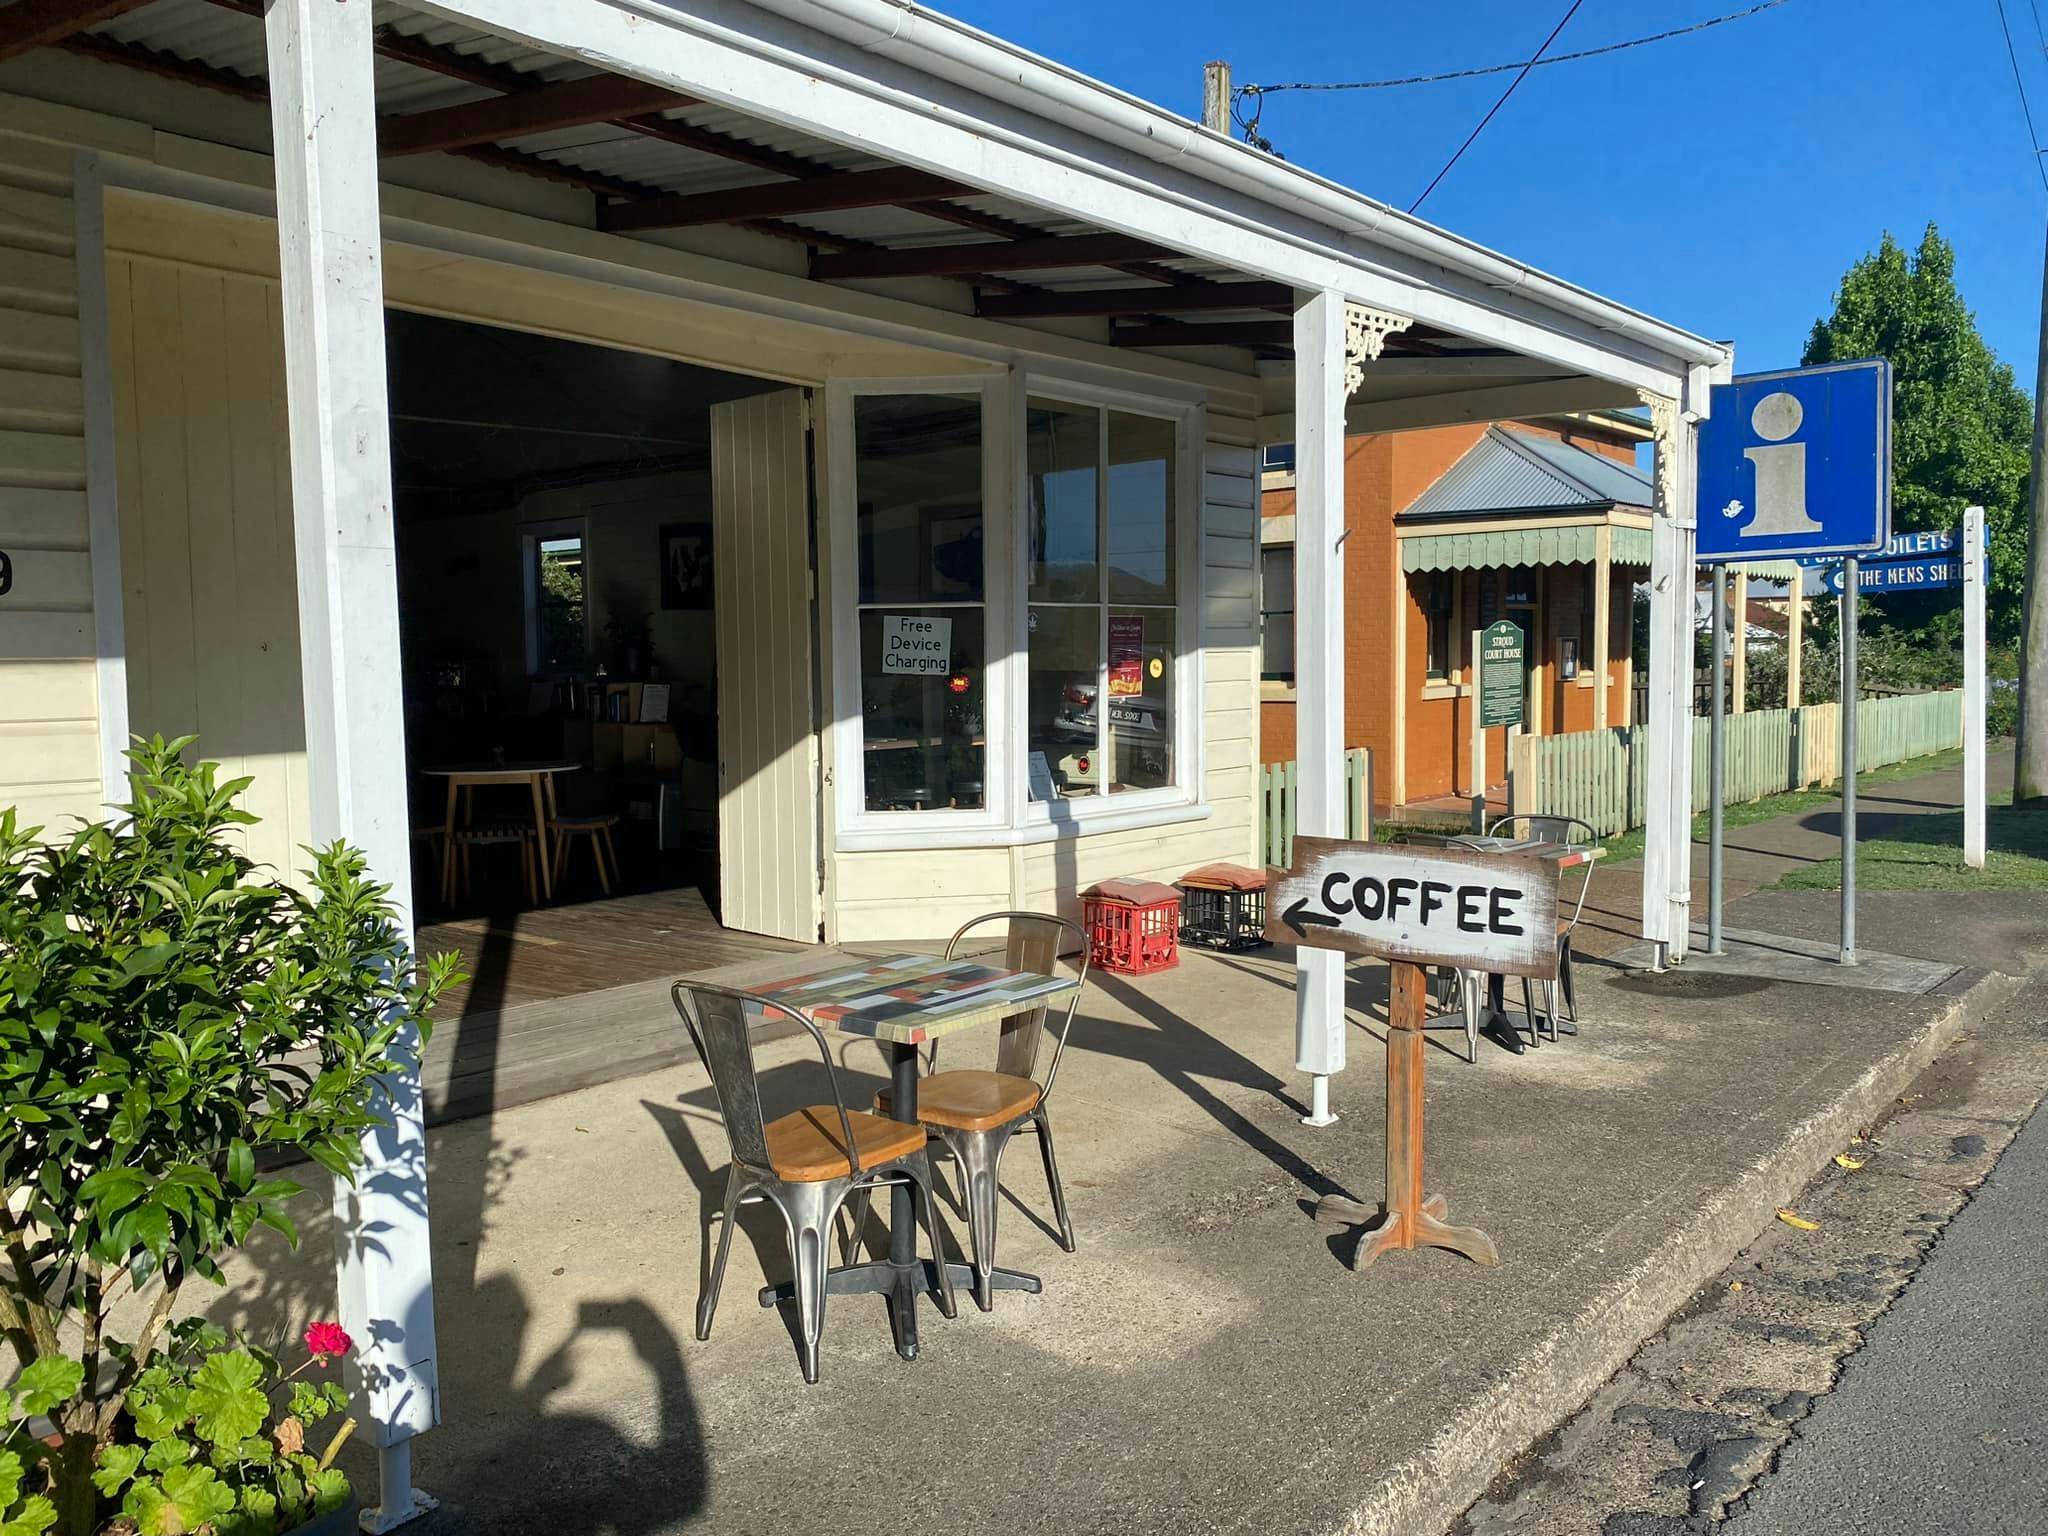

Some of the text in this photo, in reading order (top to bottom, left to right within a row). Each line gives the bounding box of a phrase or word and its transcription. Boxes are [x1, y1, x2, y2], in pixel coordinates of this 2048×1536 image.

[1858, 570, 1883, 586] THE
[1887, 566, 1925, 584] MENS
[900, 617, 933, 633] Free
[891, 635, 942, 651] Device
[885, 653, 947, 673] Charging
[1485, 648, 1521, 660] COURT HOUSE
[1321, 871, 1524, 937] COFFEE
